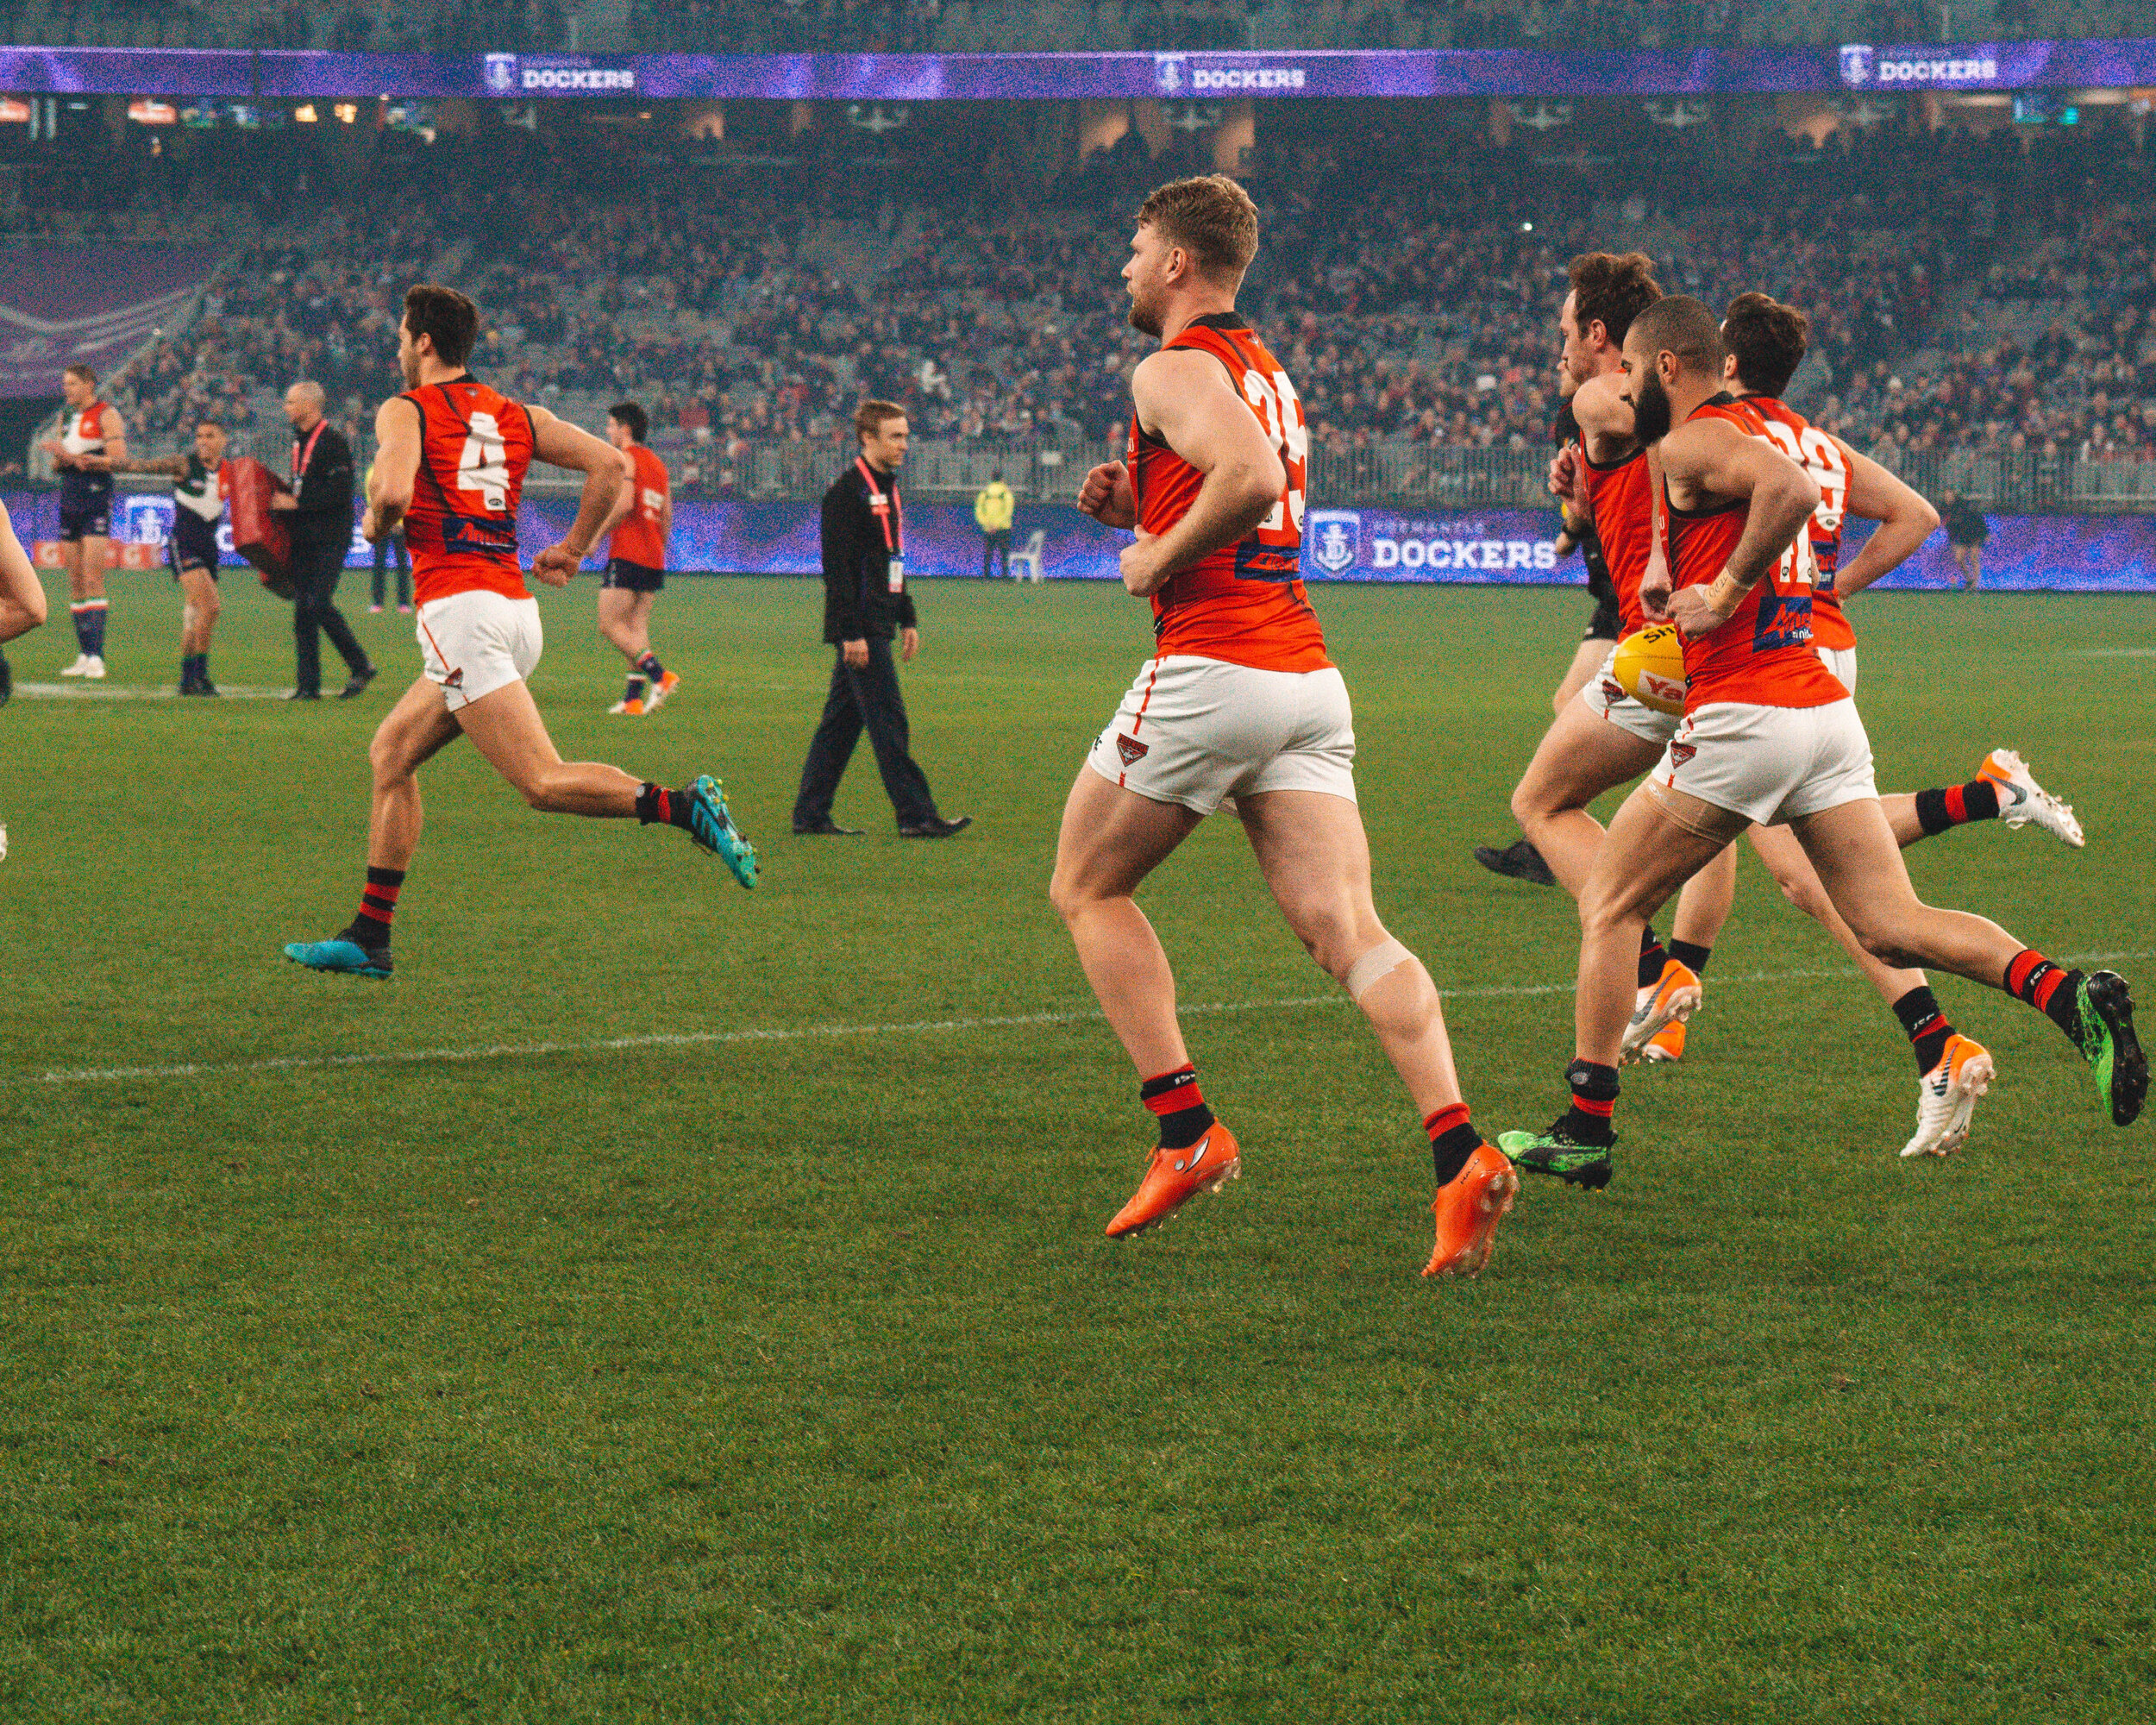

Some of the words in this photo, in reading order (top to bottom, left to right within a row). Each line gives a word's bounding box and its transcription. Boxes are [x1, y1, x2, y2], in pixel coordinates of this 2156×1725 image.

[523, 69, 634, 88] DOCKERS
[1193, 69, 1305, 88] DOCKERS
[1879, 60, 1996, 80] DOCKERS
[457, 411, 511, 511] 4
[1373, 539, 1556, 568] DOCKERS
